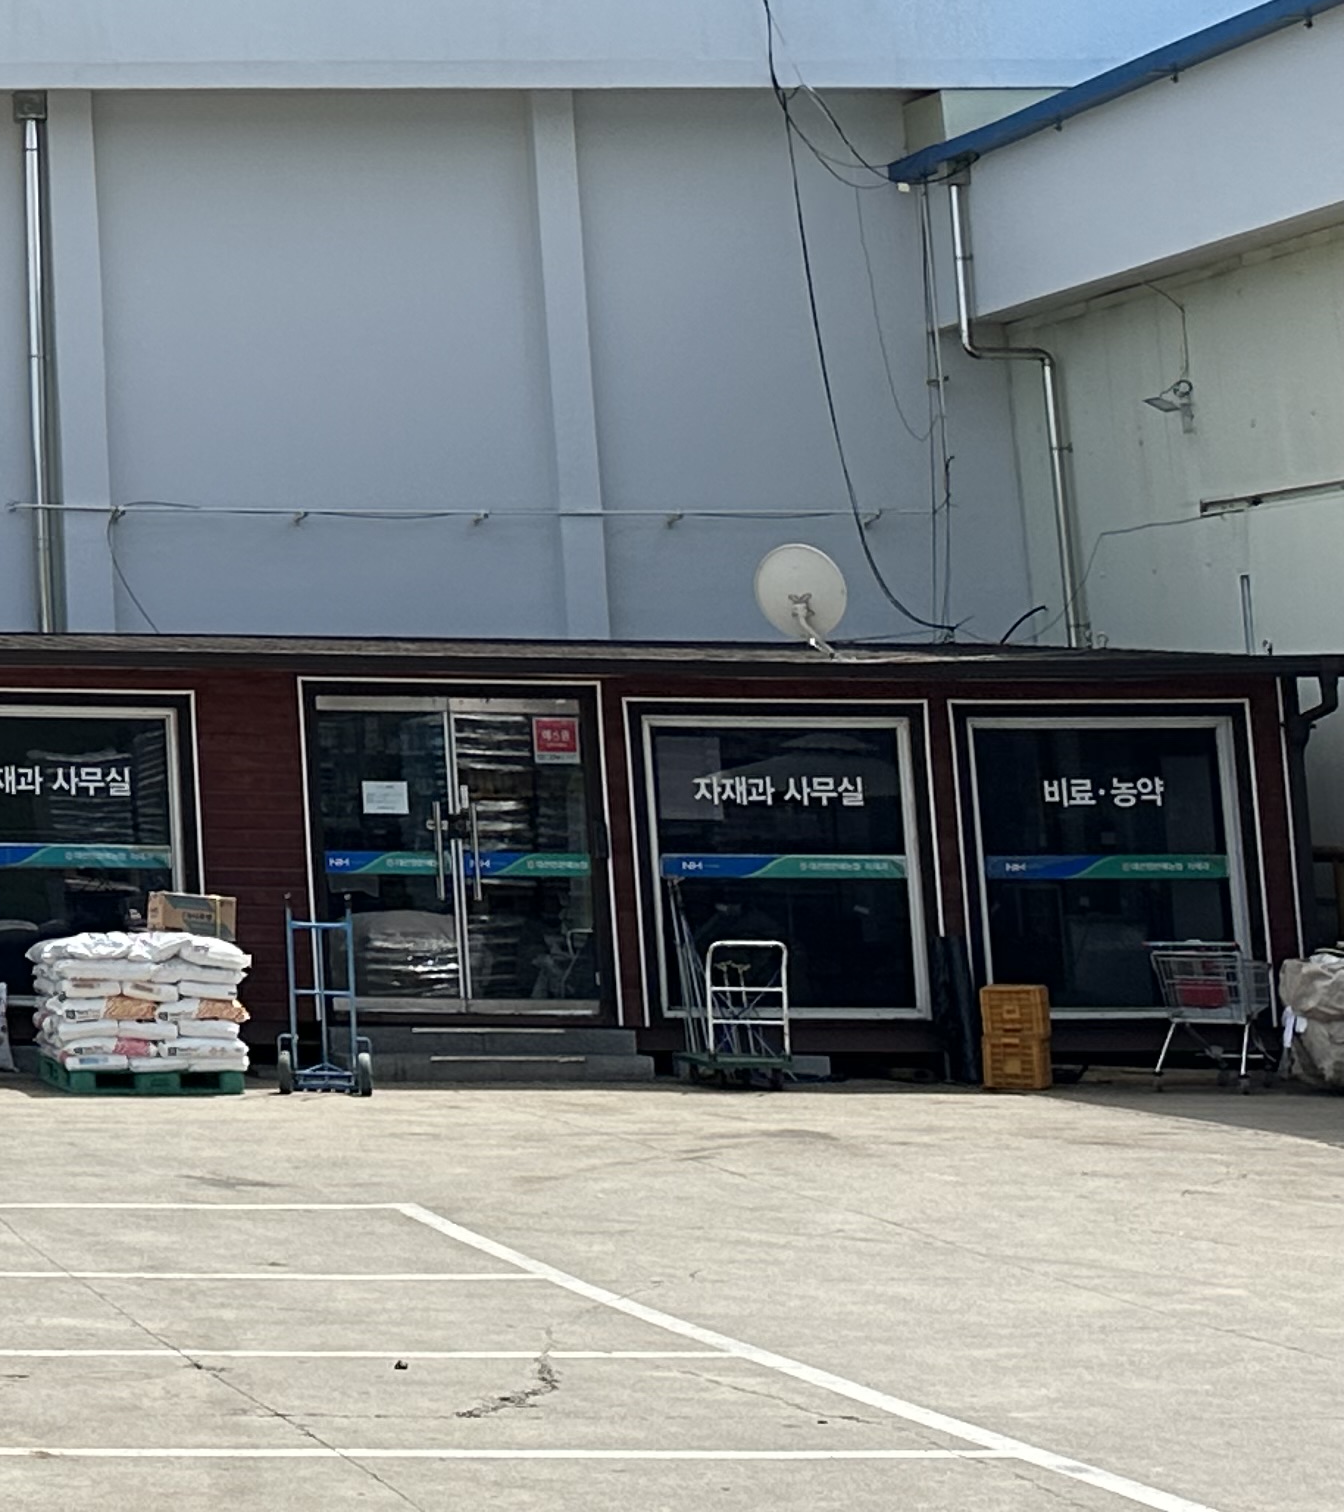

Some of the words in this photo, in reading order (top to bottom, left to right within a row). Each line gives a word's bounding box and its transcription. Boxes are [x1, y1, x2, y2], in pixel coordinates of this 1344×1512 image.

[52, 765, 132, 797] 사무실
[692, 776, 775, 805] 자재과
[784, 776, 865, 807] 사무실
